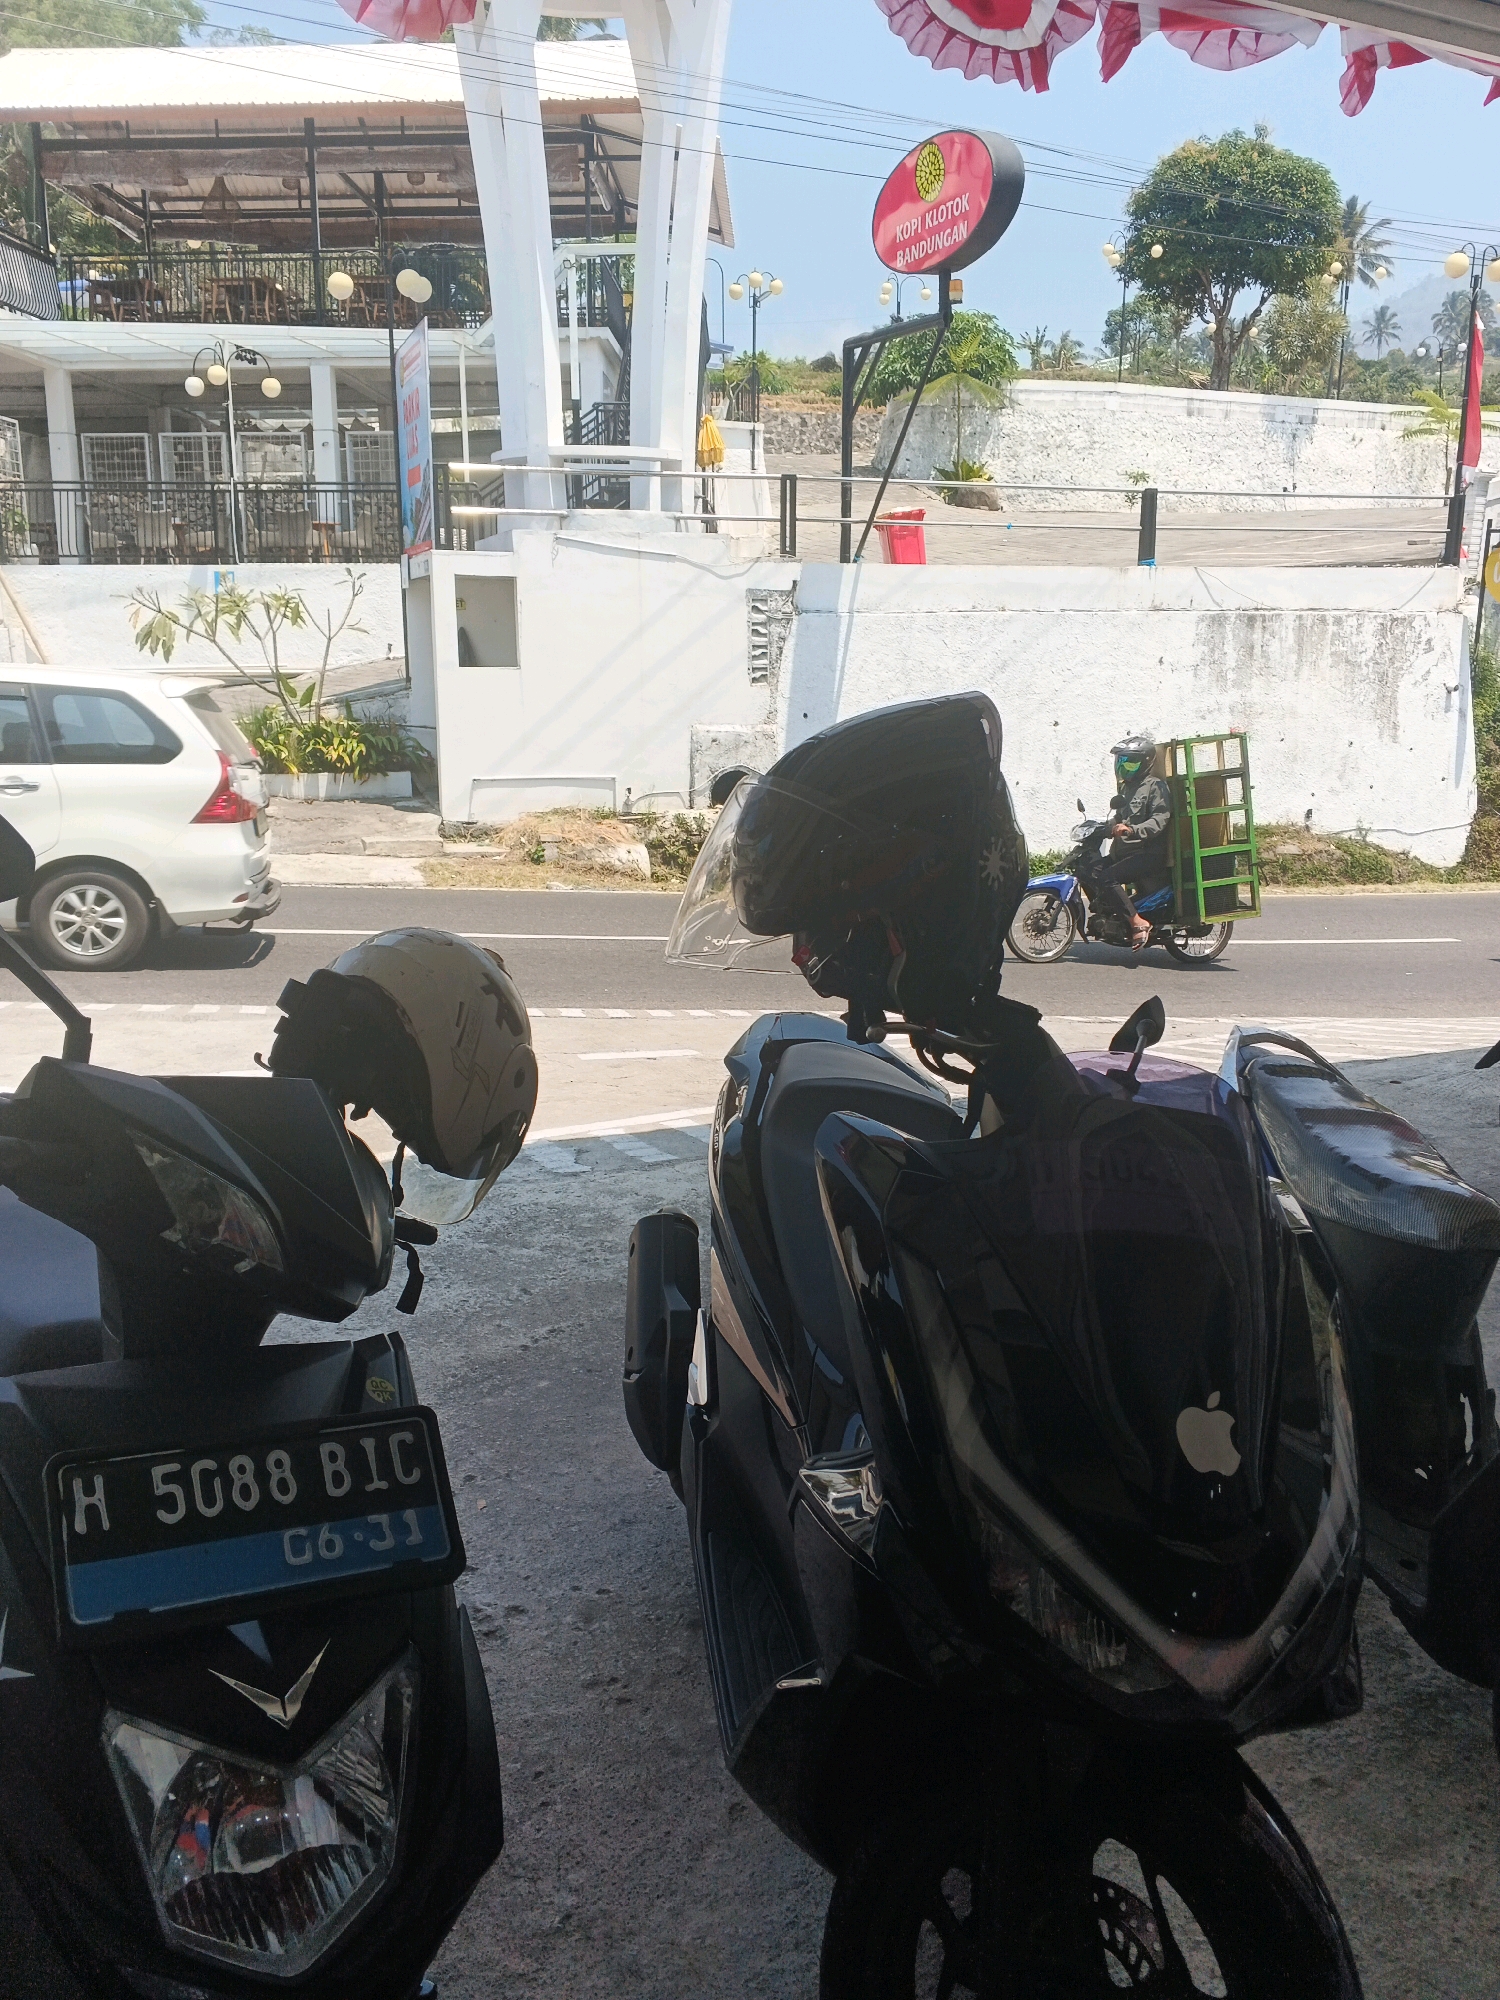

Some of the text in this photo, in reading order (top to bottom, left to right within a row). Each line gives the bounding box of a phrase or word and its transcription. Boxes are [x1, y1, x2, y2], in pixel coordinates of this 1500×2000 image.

[896, 193, 970, 243] KOPI KLOTOK
[896, 220, 968, 267] BANDUNGAN
[370, 1379, 388, 1390] QC
[73, 1431, 421, 1534] H 5088 BIC
